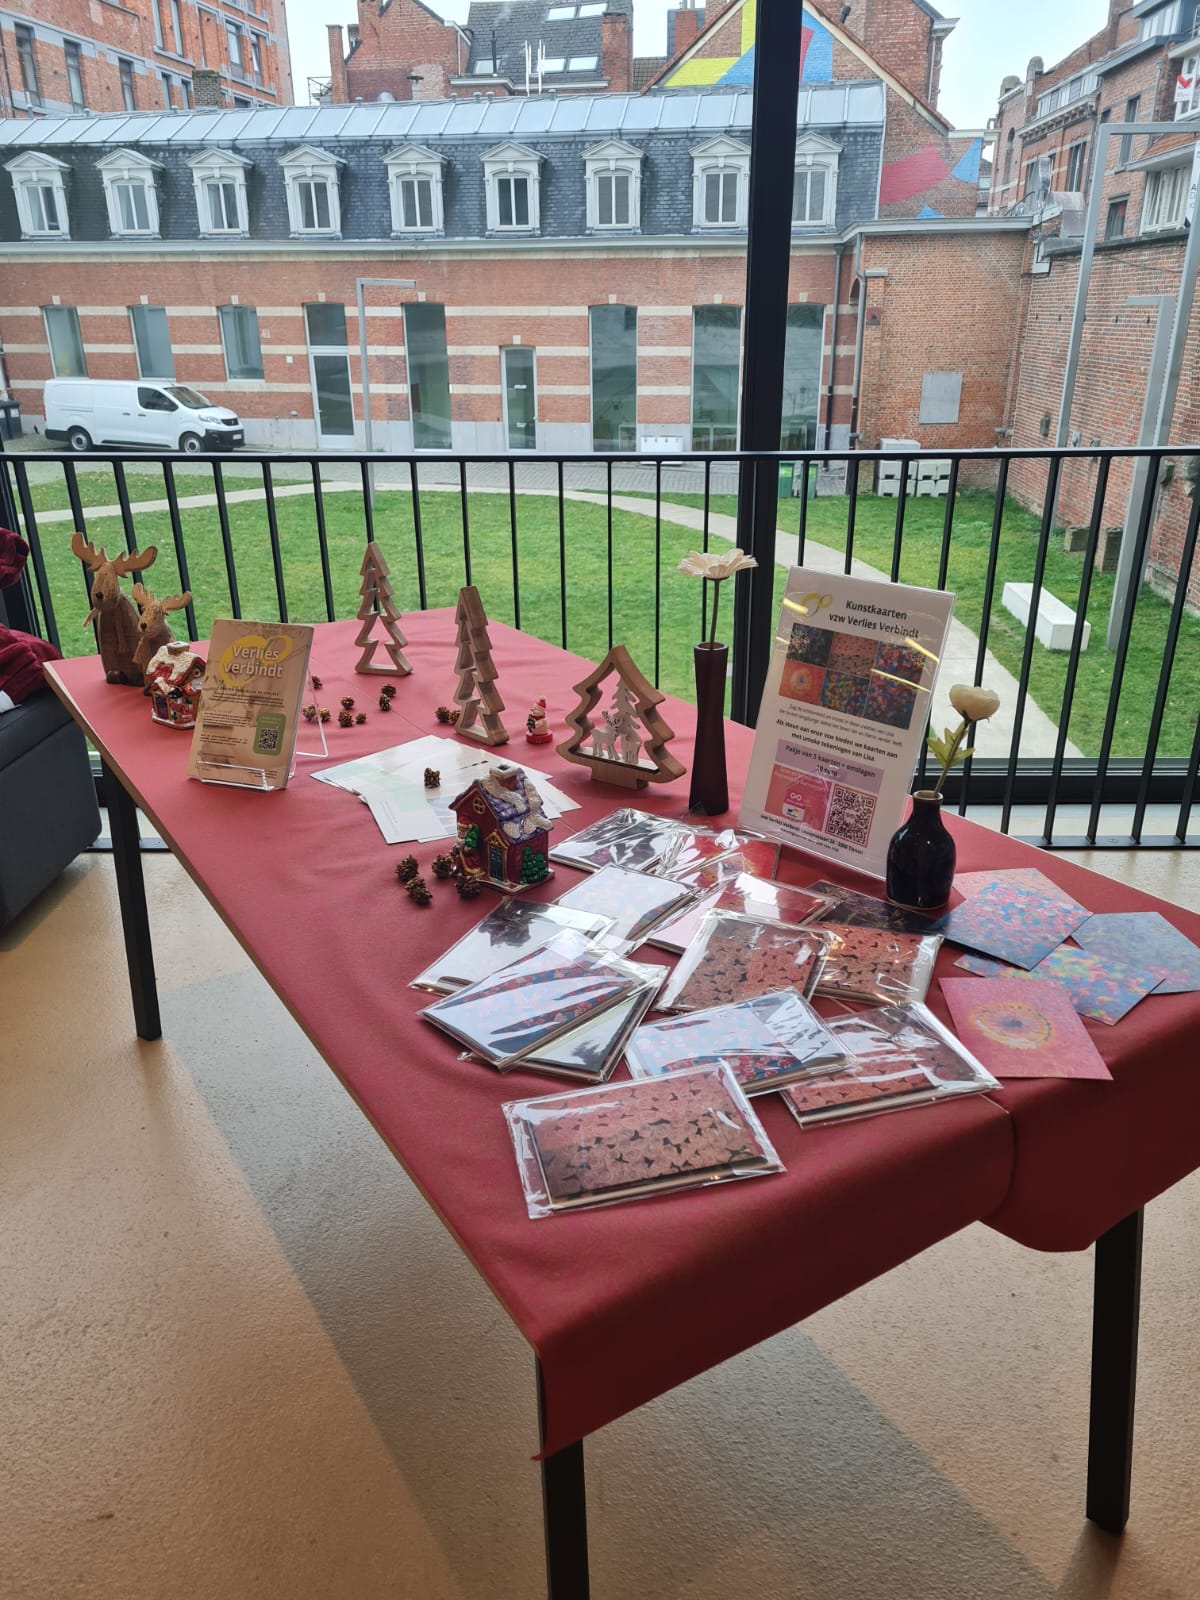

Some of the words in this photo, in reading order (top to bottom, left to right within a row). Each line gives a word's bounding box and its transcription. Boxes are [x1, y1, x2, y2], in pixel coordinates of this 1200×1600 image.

[845, 600, 907, 620] Kunstkaarten
[829, 613, 845, 623] vzw
[848, 615, 877, 630] Verlies
[879, 622, 920, 639] Verbindt
[233, 644, 279, 660] Verlies
[224, 661, 283, 677] verbindt
[792, 732, 802, 740] met
[803, 736, 820, 745] unieke
[821, 741, 851, 754] tekeningen
[810, 729, 823, 737] onze
[836, 736, 853, 745] bieden
[864, 744, 885, 755] kaarten
[785, 745, 801, 755] Pakje
[818, 755, 841, 767] kaarten
[847, 765, 876, 777] omslagen
